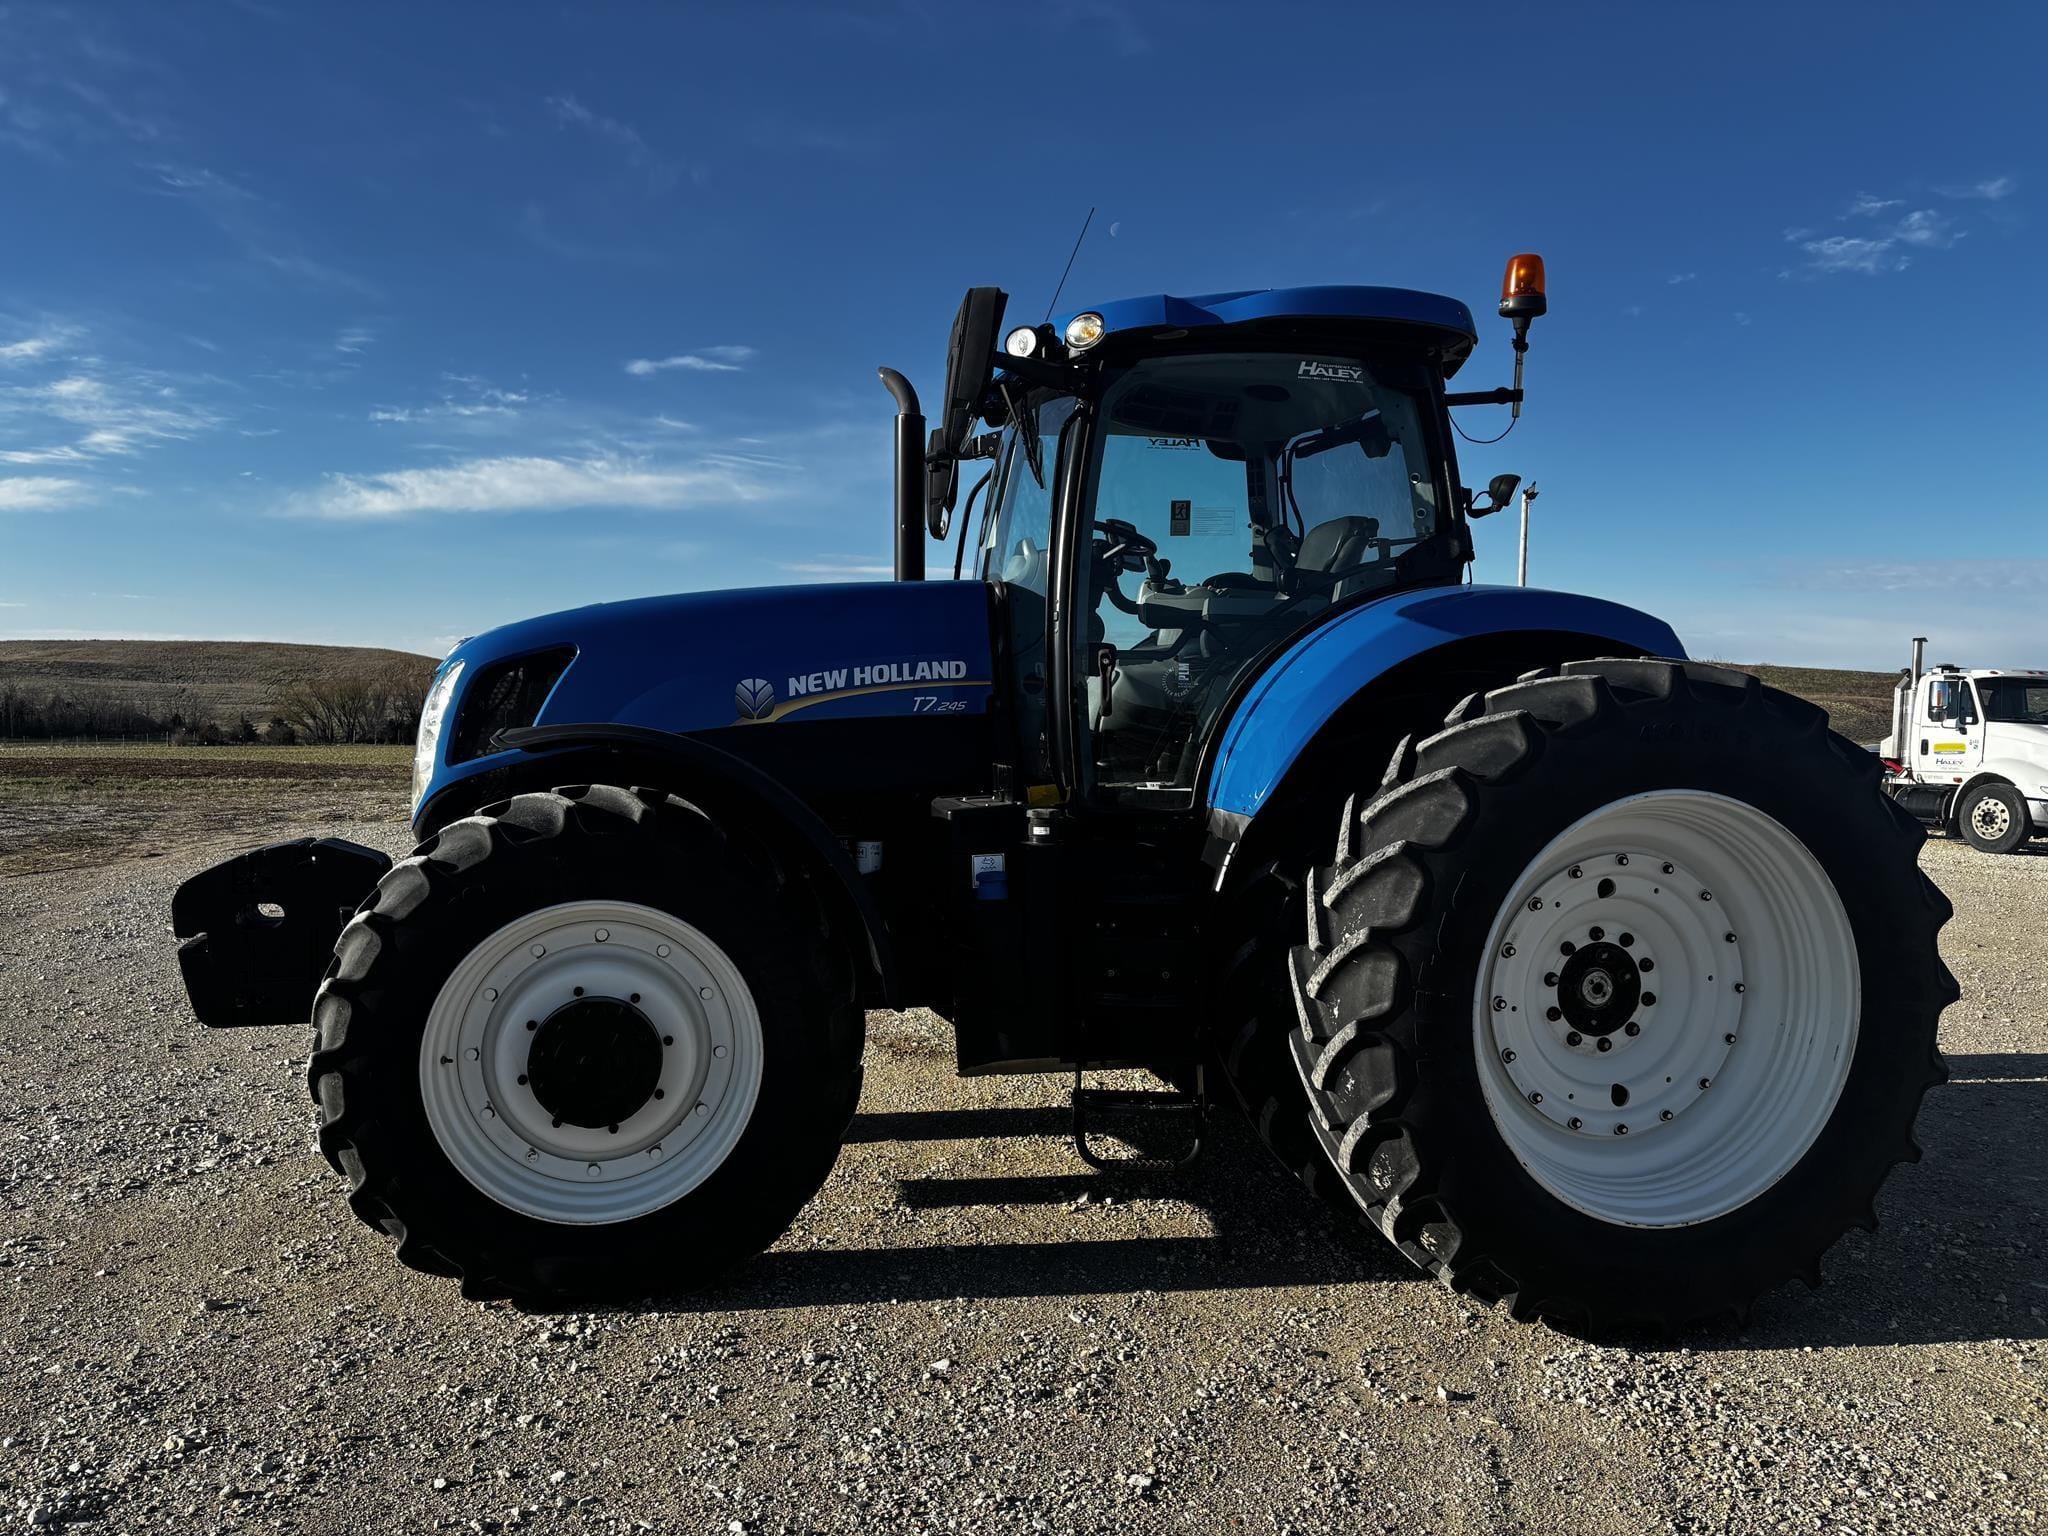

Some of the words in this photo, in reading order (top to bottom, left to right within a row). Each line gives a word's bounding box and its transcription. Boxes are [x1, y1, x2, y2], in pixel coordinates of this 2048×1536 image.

[1298, 361, 1363, 379] HALEY
[788, 668, 848, 697] NEW
[854, 660, 967, 686] HOLLAND
[1178, 664, 1190, 681] PLM
[912, 696, 968, 712] T7.245
